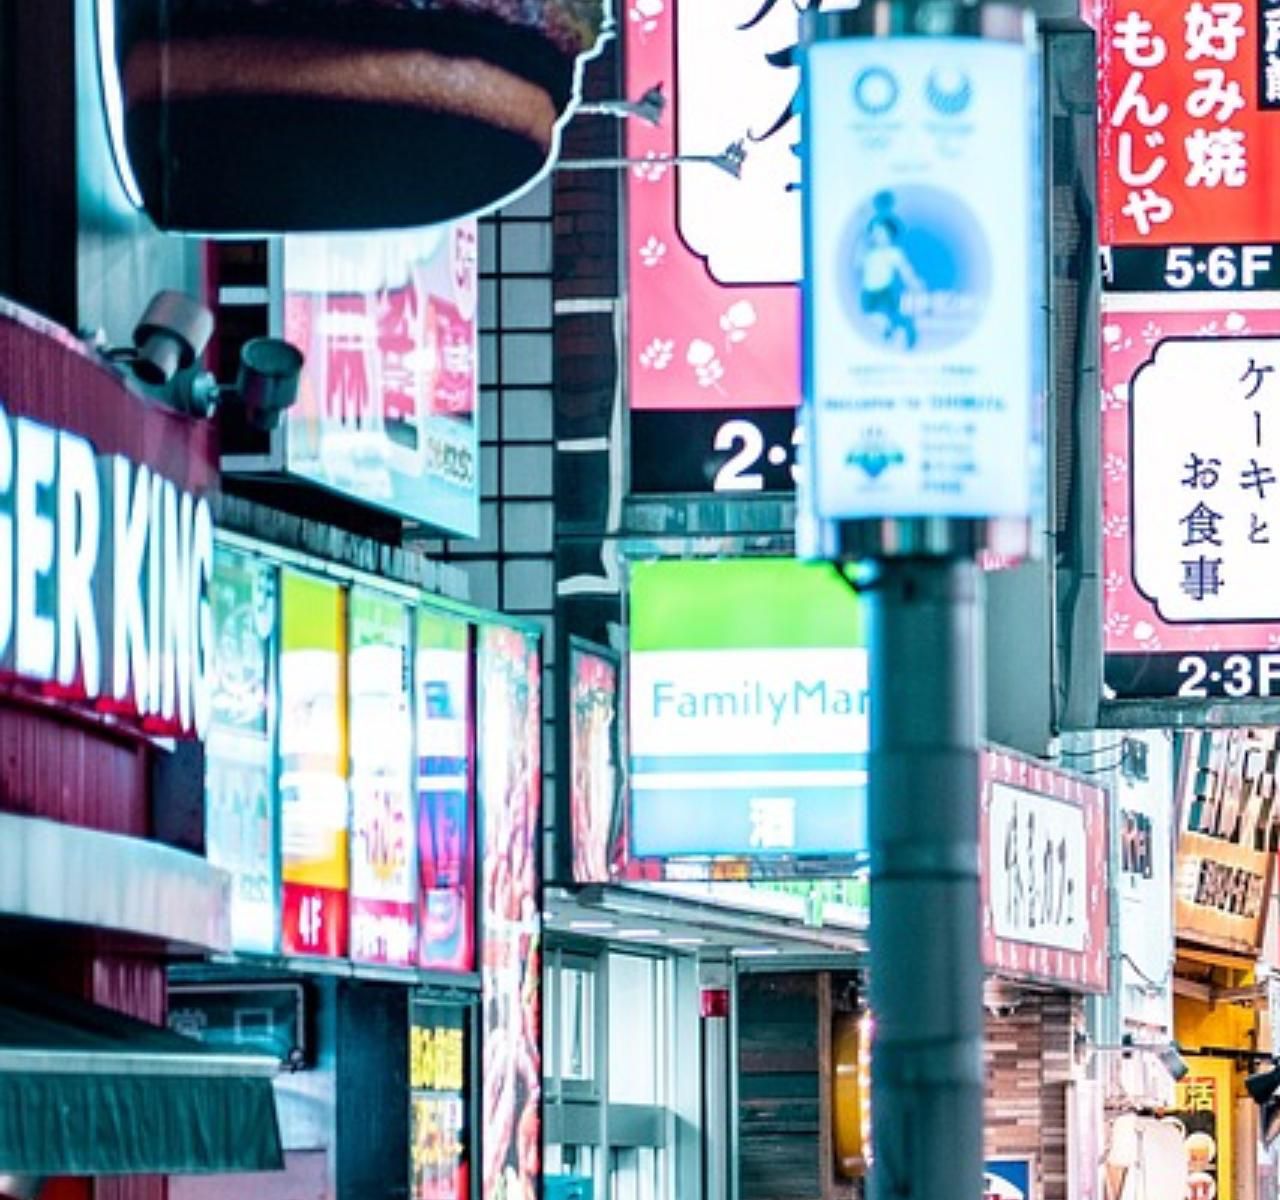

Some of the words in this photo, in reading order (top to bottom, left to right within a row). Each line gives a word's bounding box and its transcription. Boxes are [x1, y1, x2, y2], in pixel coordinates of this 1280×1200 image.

[1111, 11, 1174, 235] もんじゃ
[1179, 452, 1225, 601] お食事
[1239, 358, 1277, 544] ケーキと
[113, 452, 214, 742] KING
[652, 679, 866, 727] FamilyMar
